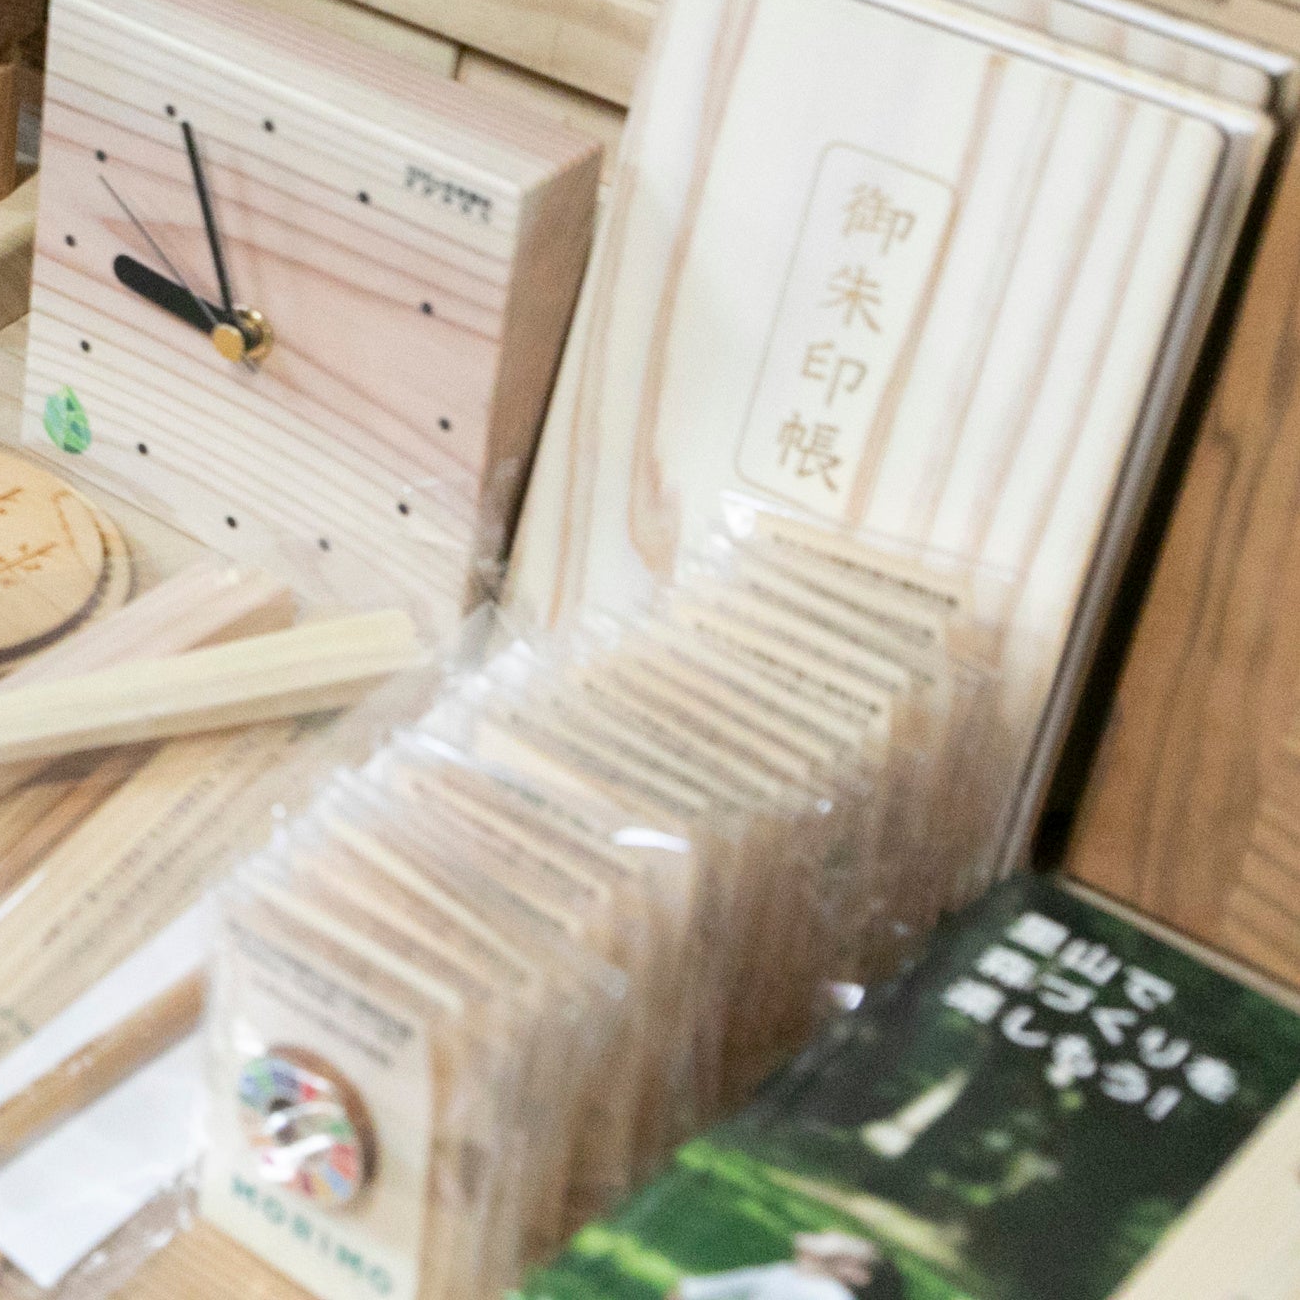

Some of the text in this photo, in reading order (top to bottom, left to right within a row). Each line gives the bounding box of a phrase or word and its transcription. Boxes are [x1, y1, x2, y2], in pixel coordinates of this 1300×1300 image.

[777, 182, 918, 494] 御朱印帳
[230, 1174, 395, 1297] MORIMO
